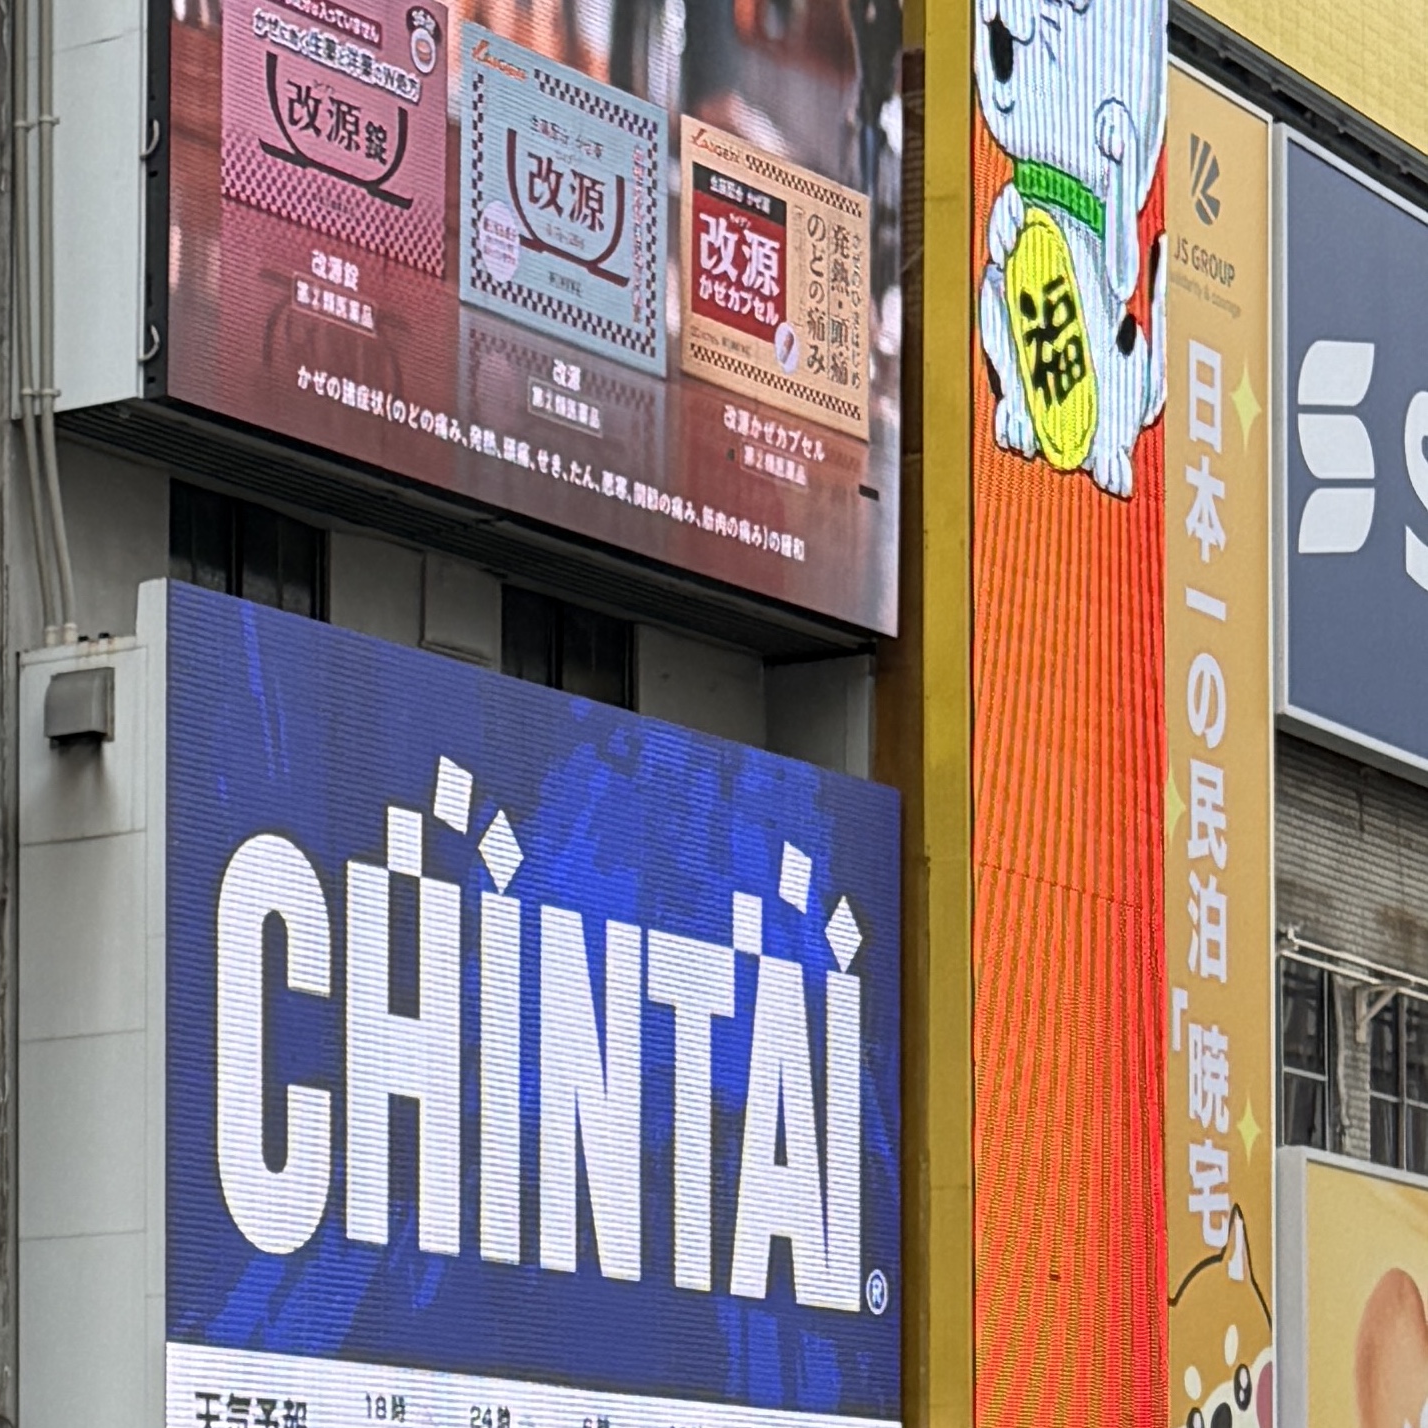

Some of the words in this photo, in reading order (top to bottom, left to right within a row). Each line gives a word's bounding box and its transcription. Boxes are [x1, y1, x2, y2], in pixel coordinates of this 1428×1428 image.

[286, 79, 387, 165] 改源錠
[527, 151, 605, 232] 改源
[698, 212, 781, 297] 改源
[807, 213, 827, 375] のどの痛み
[1174, 235, 1189, 265] JS
[1192, 244, 1236, 288] GROUP
[699, 274, 779, 326] かぜカプセル
[216, 756, 863, 1312] CHINTAI
[364, 1392, 406, 1424] 18時
